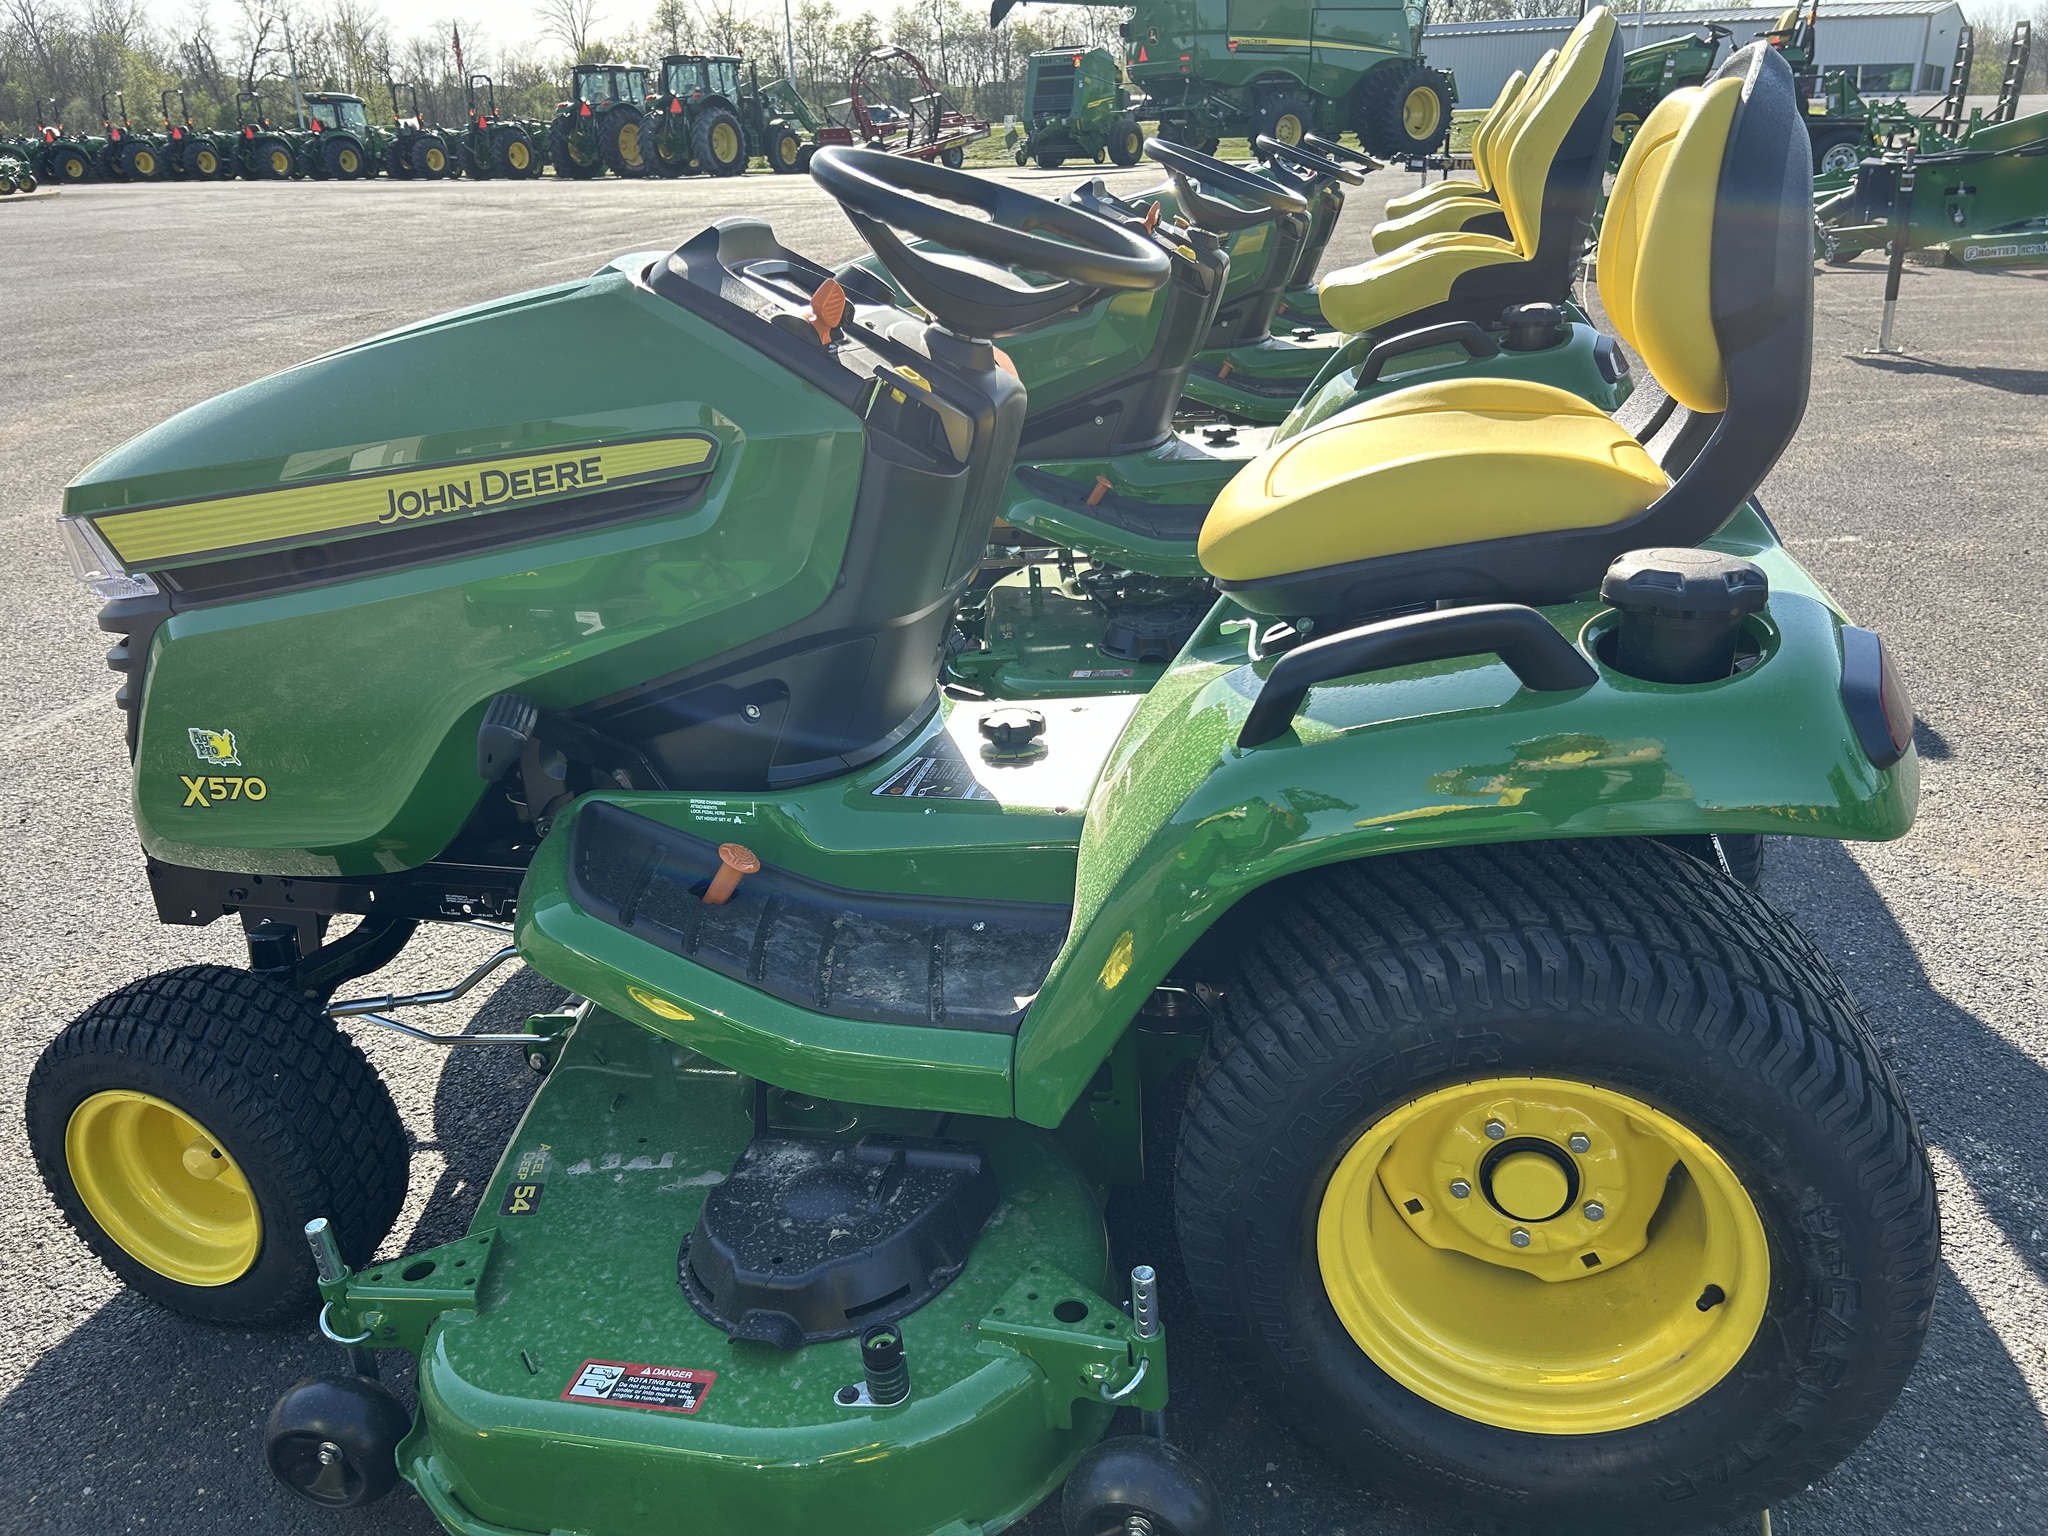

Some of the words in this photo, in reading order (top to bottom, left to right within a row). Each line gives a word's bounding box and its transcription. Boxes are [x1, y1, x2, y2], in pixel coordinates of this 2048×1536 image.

[1965, 246, 2016, 259] FRONTIER
[378, 480, 473, 522] JOHN
[479, 455, 604, 502] DEERE
[192, 731, 214, 746] Ag-
[196, 743, 220, 756] Pro
[178, 775, 268, 808] X570
[508, 1185, 536, 1214] 54
[652, 1368, 693, 1378] DANGER
[628, 1376, 665, 1385] ROTATING
